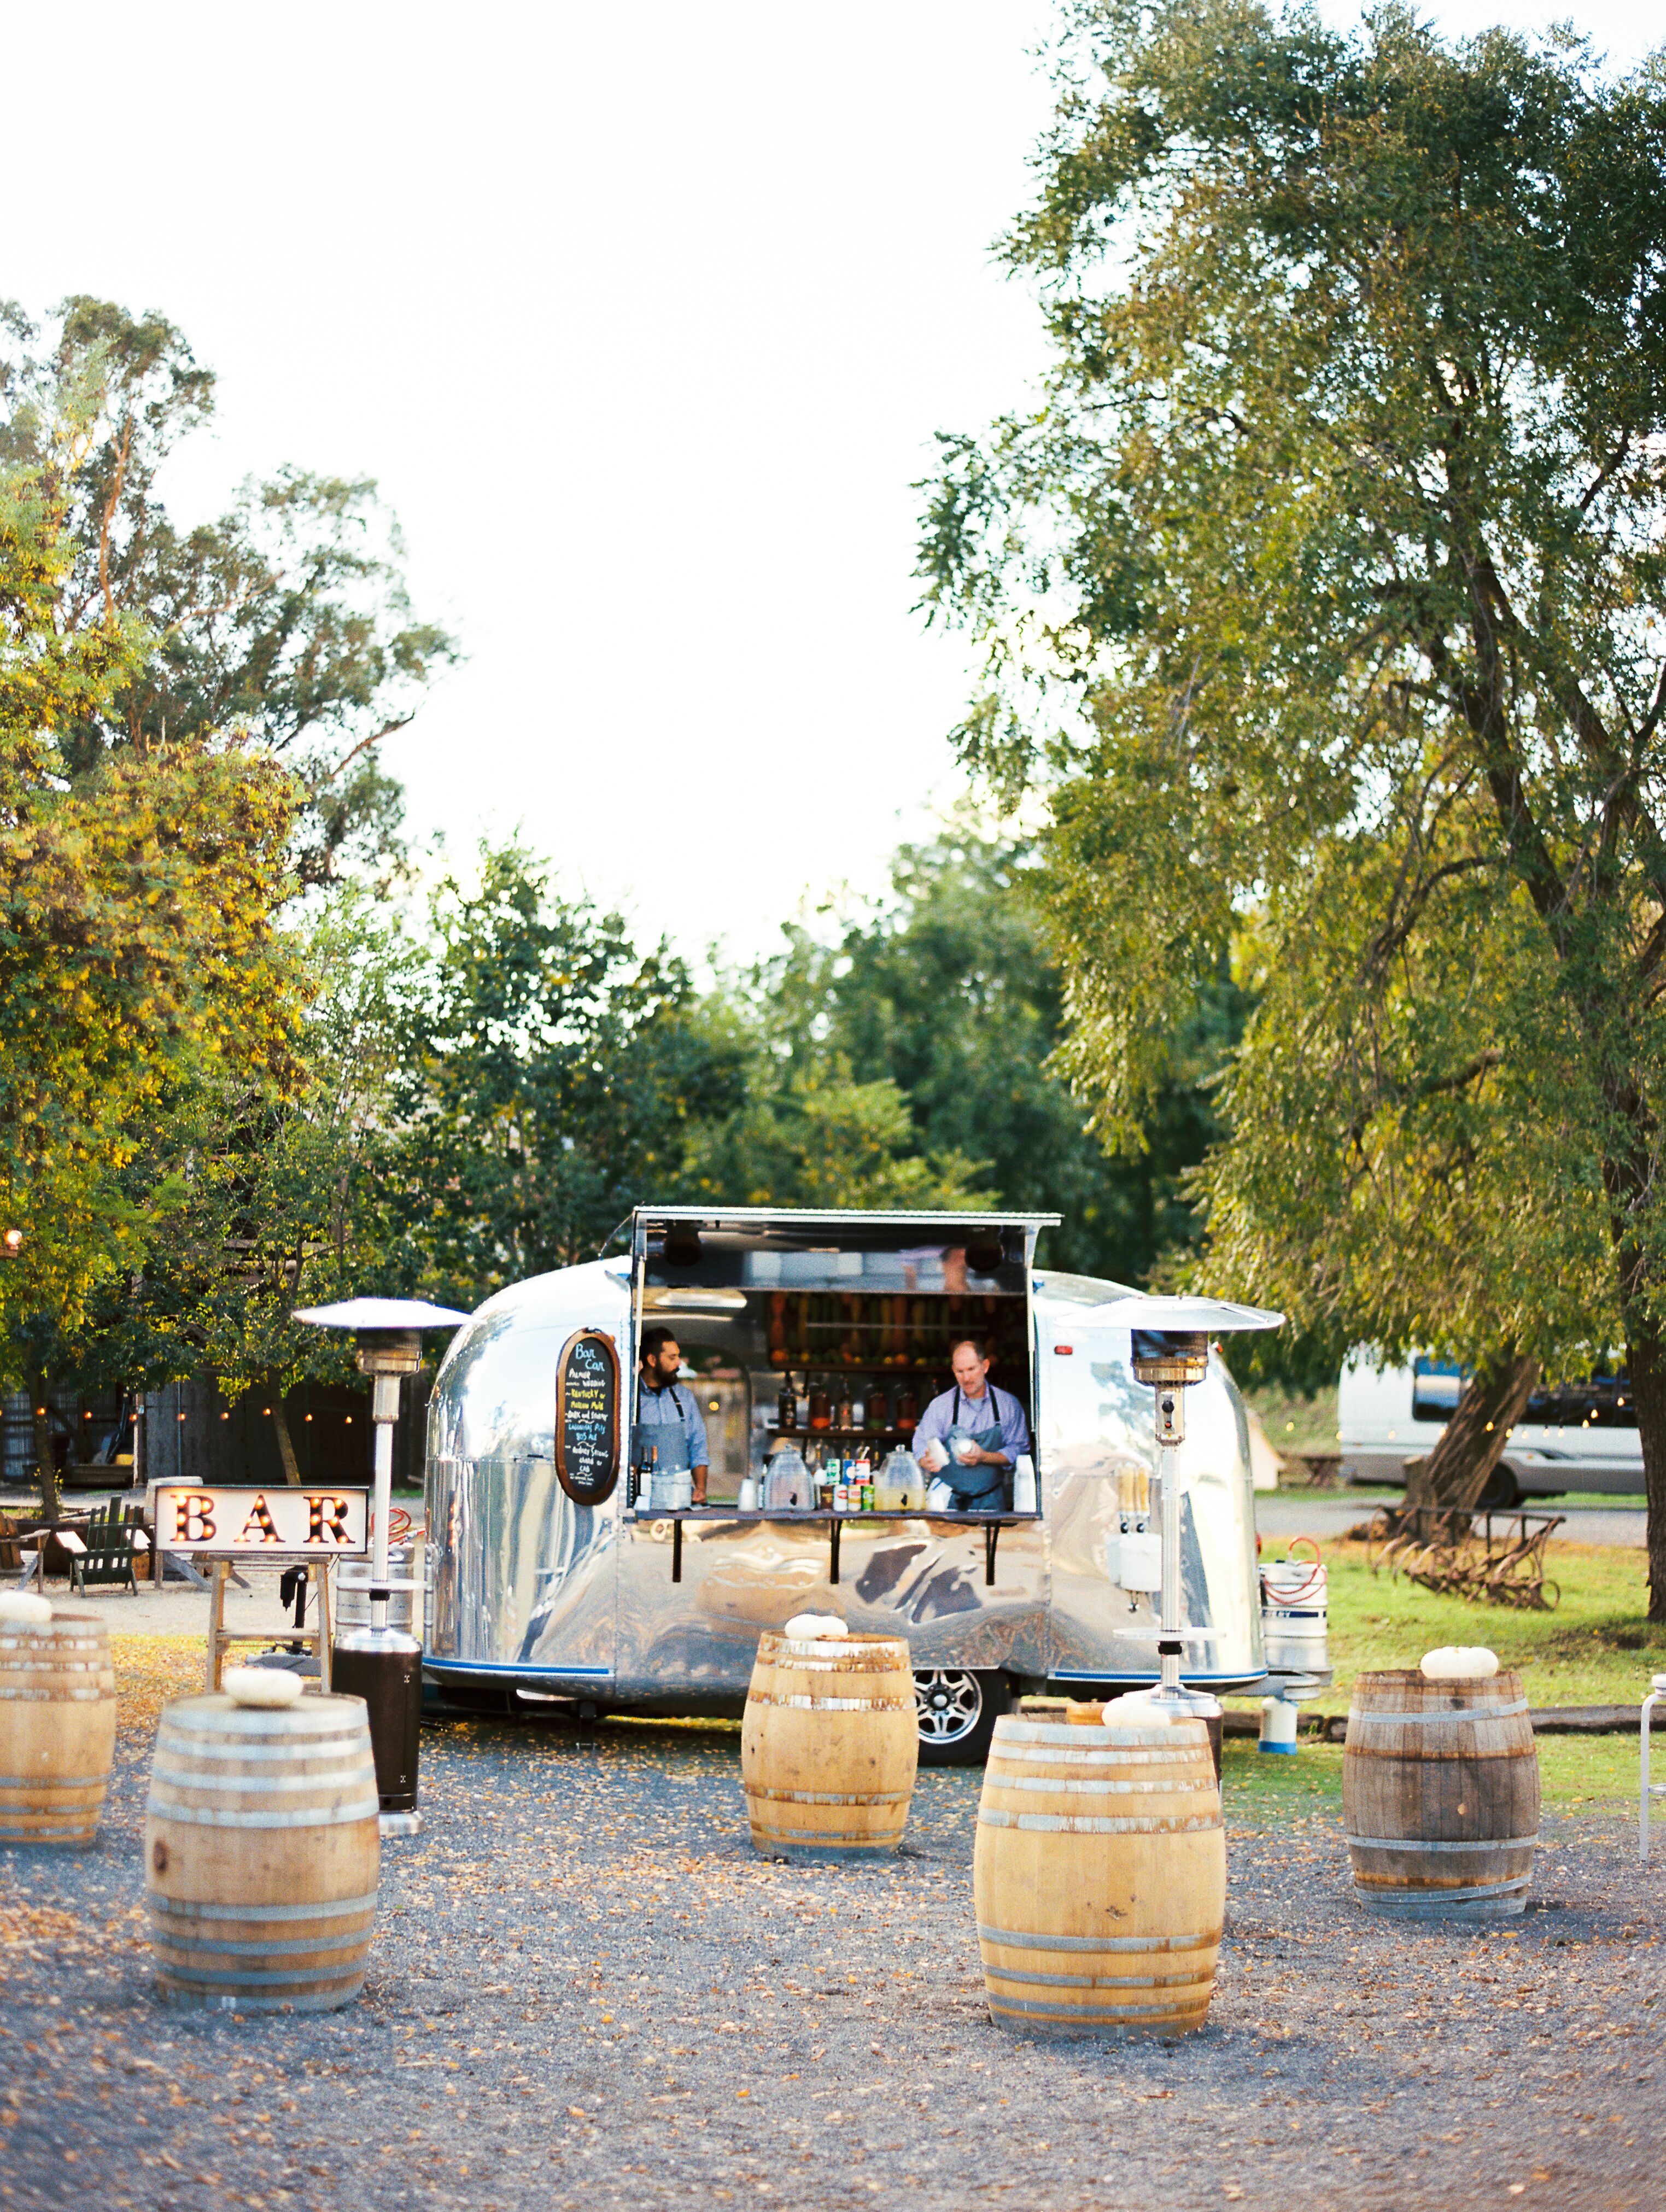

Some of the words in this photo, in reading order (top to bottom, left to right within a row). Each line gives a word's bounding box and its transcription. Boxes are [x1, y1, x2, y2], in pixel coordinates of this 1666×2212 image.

[576, 1343, 595, 1359] Bar
[585, 1359, 605, 1372] Car
[169, 1494, 355, 1543] BAR
